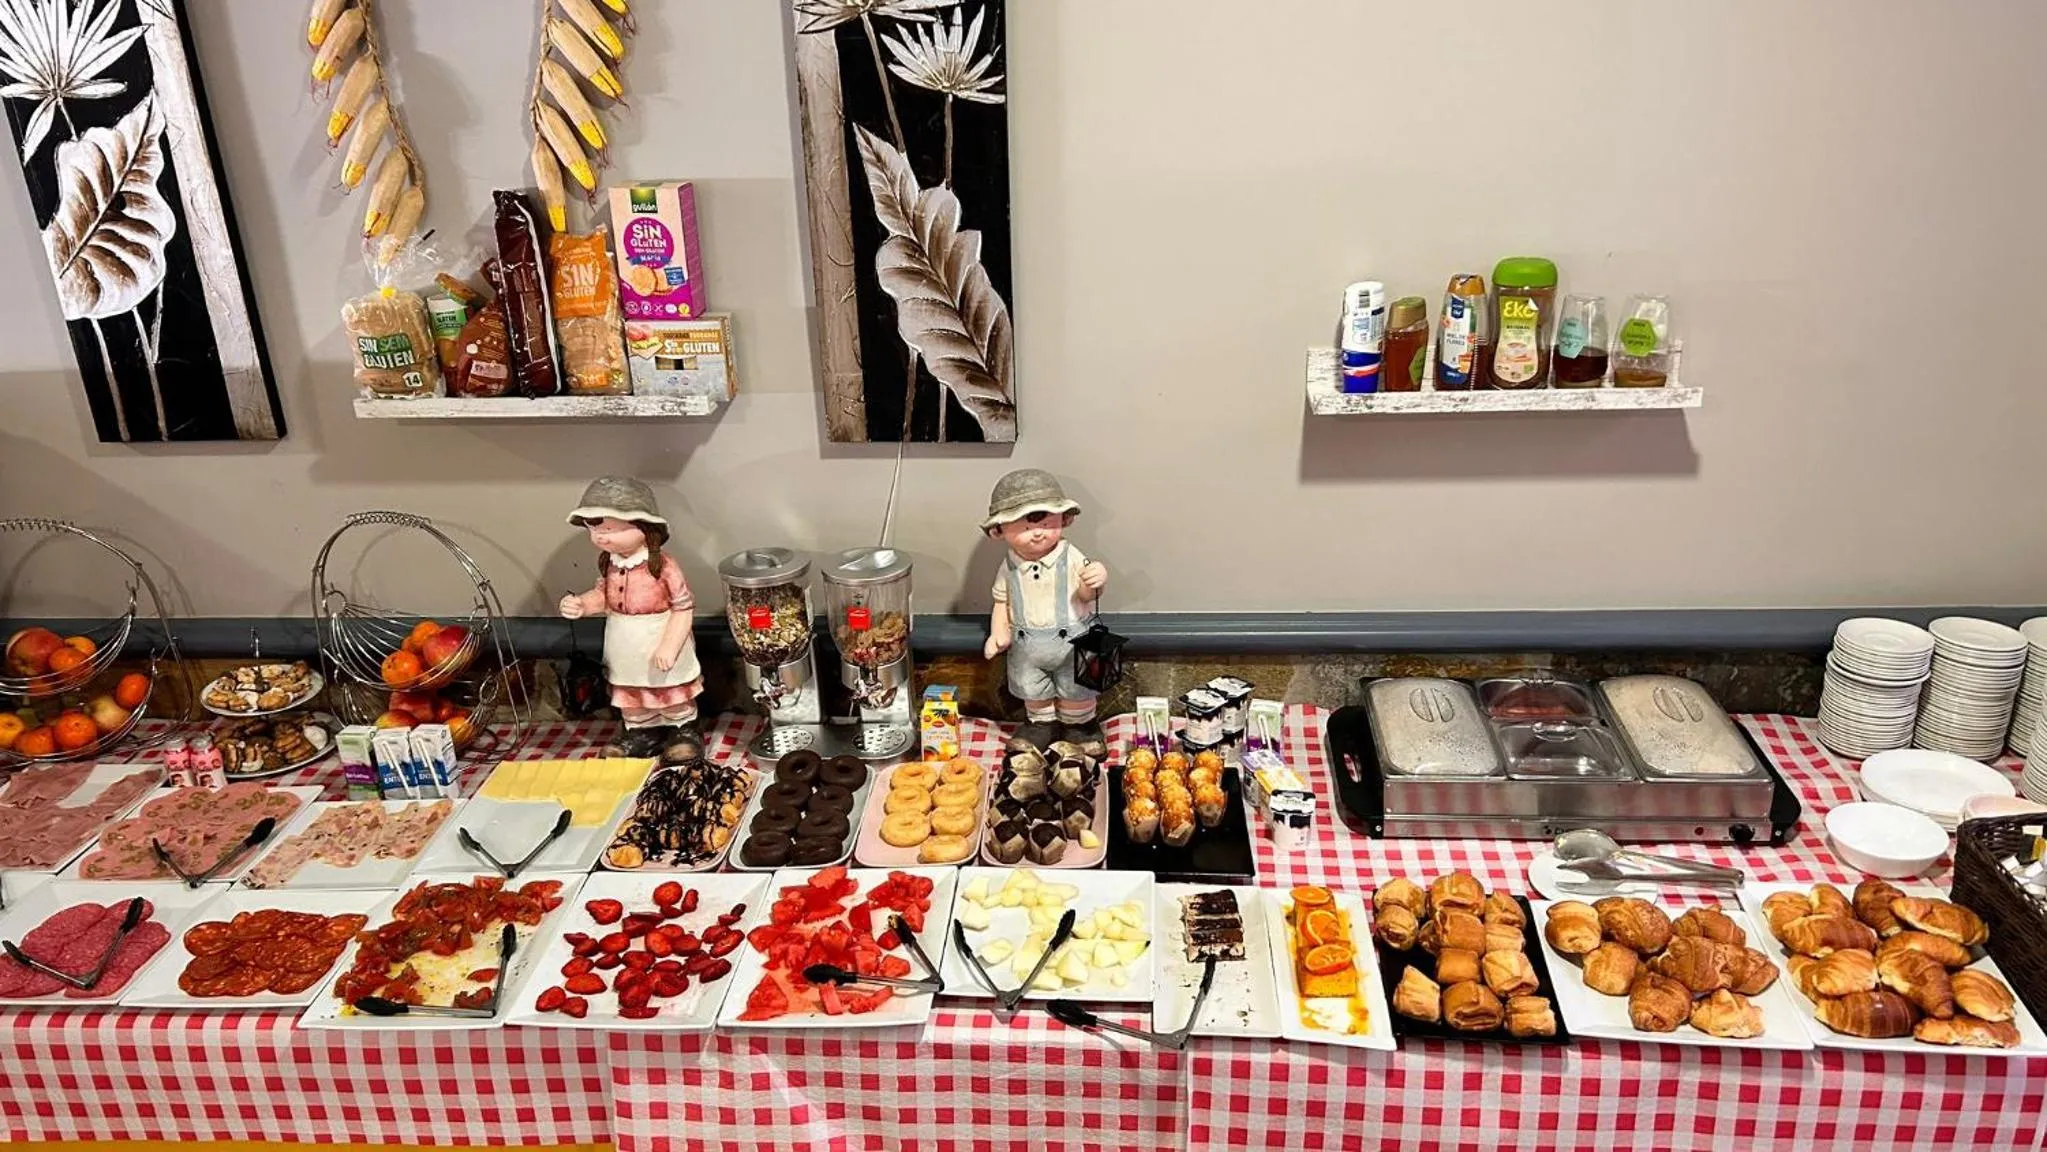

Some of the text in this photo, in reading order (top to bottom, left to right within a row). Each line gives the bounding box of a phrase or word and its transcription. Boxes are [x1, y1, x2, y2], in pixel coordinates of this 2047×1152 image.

[358, 338, 378, 352] SIN
[683, 342, 720, 353] GLUTEN
[364, 350, 415, 369] GLUTEN
[405, 375, 419, 386] 14
